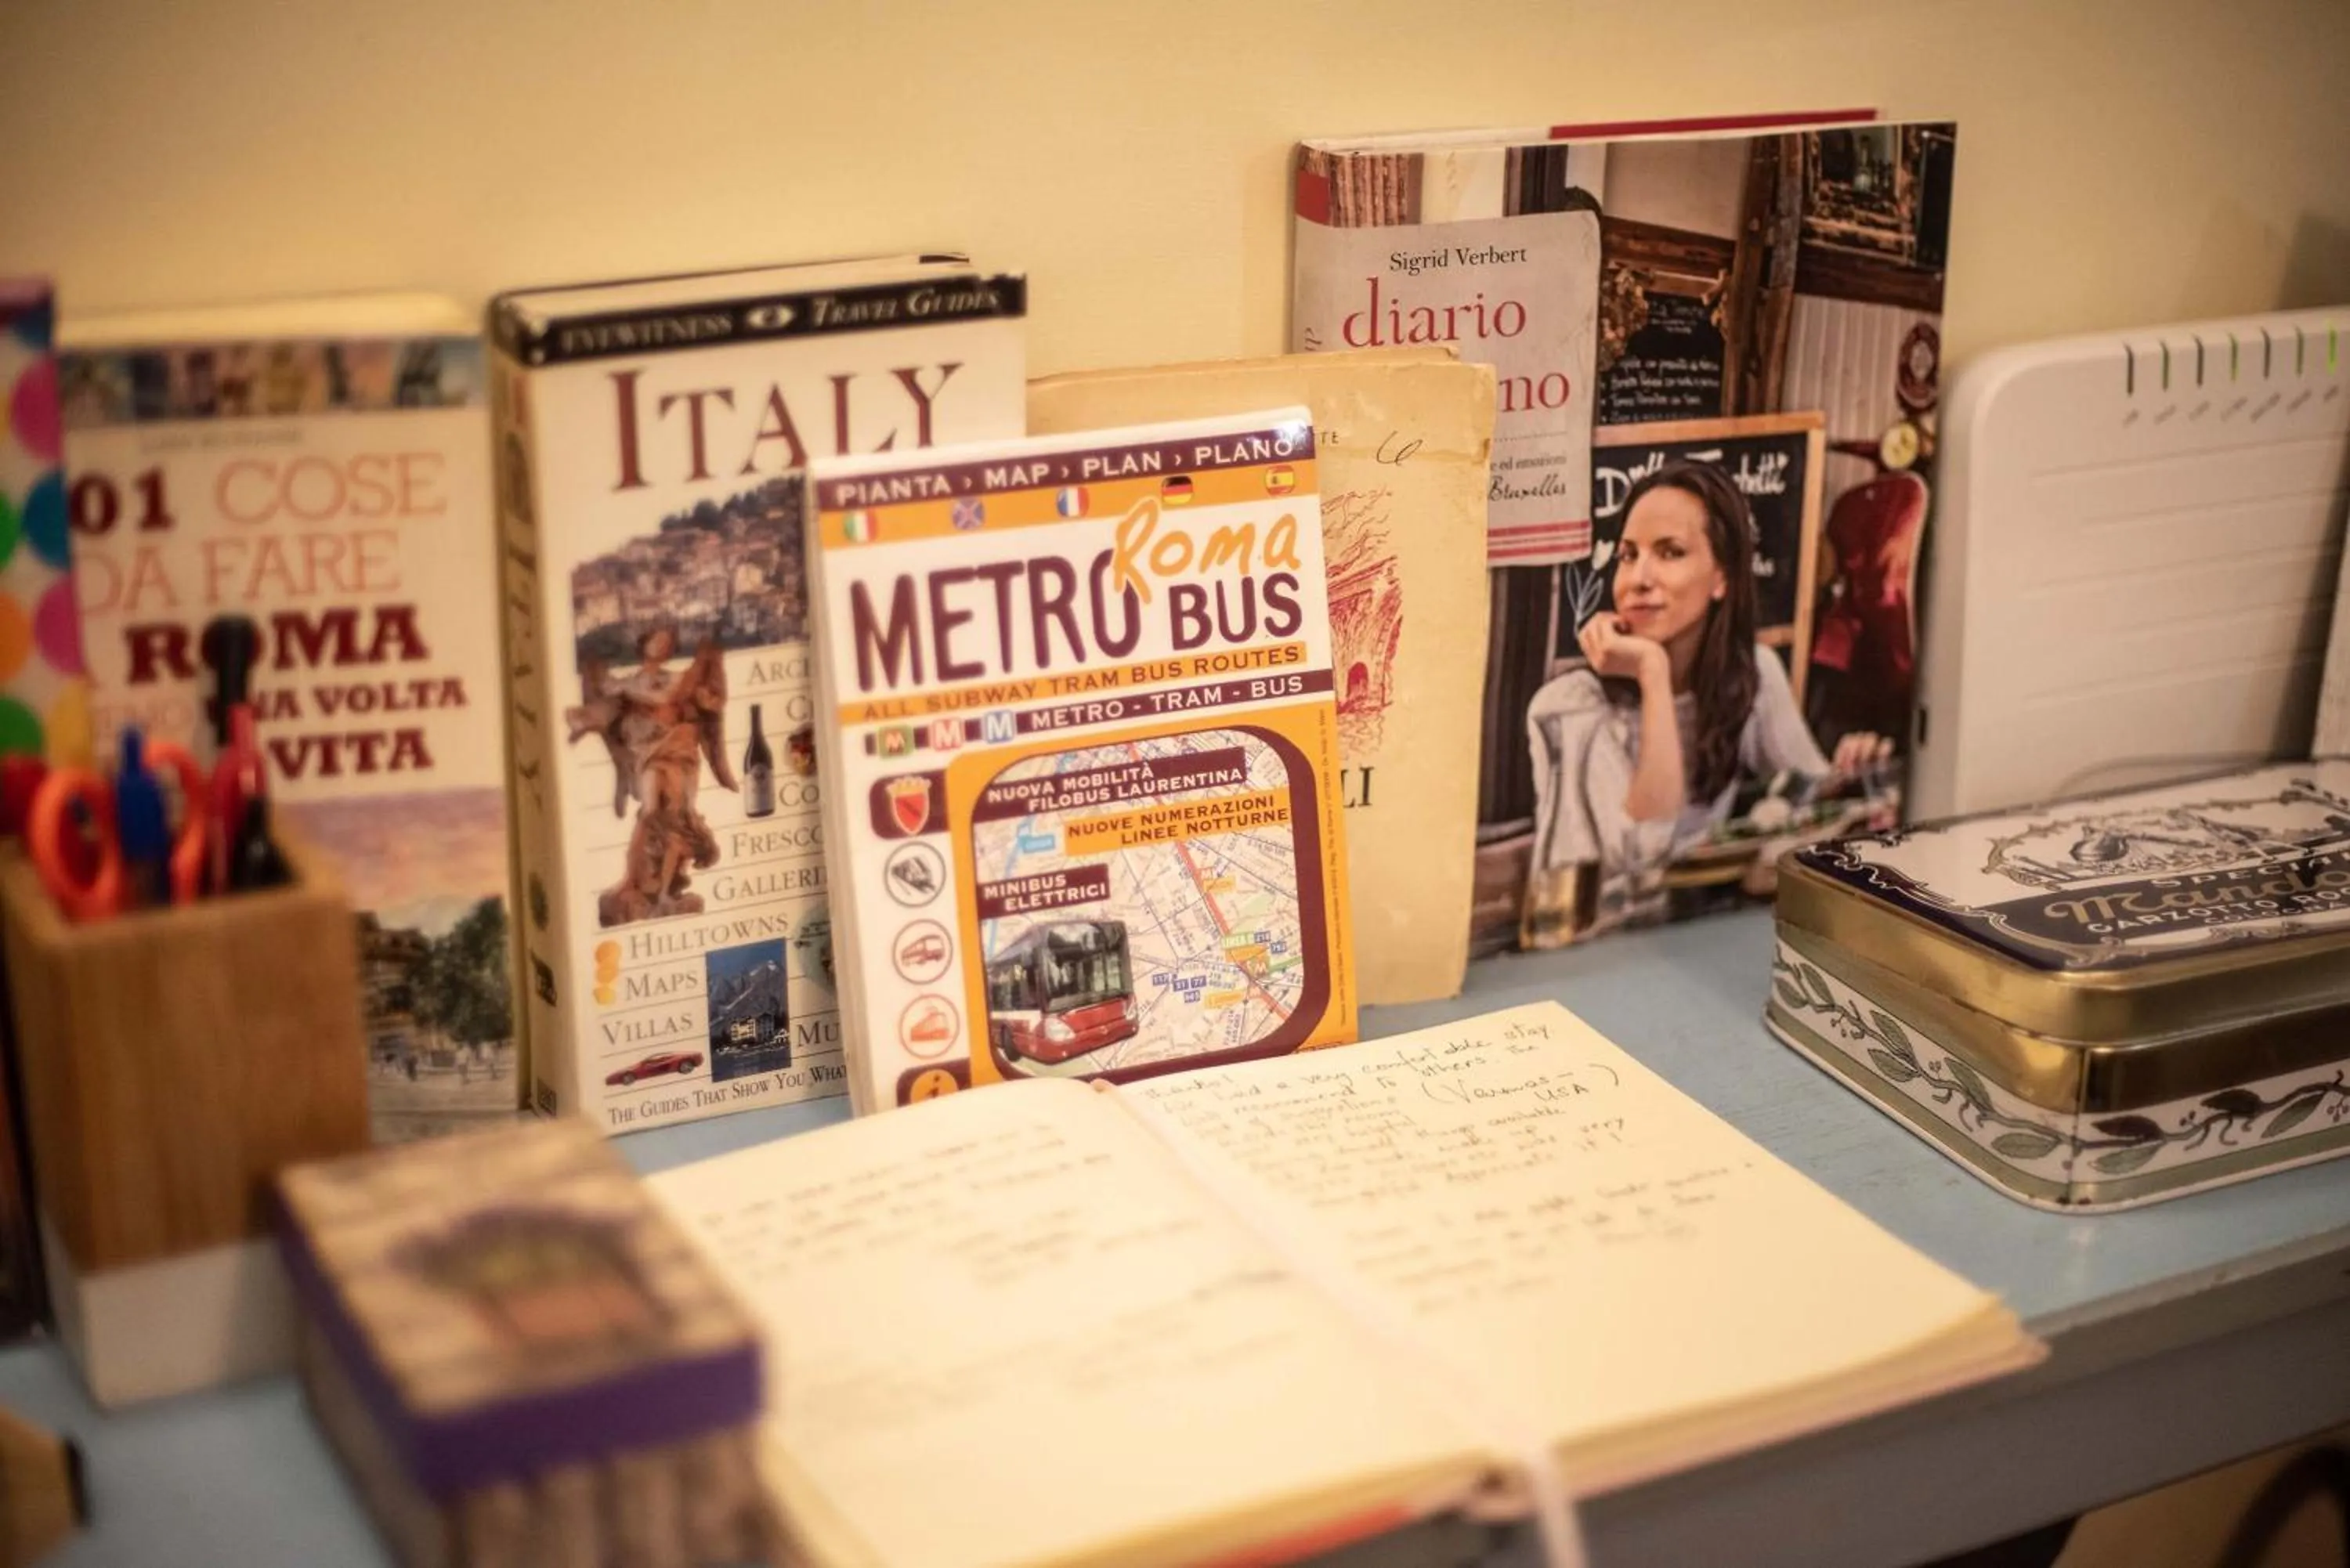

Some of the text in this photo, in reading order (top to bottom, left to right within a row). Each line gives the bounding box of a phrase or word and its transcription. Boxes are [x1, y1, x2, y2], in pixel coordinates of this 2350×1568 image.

[1390, 246, 1528, 275] Sigrid Verbert
[1343, 276, 1526, 347] diario
[213, 451, 448, 525] COSE
[836, 436, 1294, 505] PIANTA MAP PLAN PLANO
[201, 529, 403, 605] FARE
[1112, 497, 1301, 606] Roma
[850, 548, 1303, 694] METRO BUS
[311, 677, 471, 718] VOLTA
[864, 645, 1300, 721] ALL SUBWAY TRAM BUS ROUTES
[1030, 675, 1303, 732] METRO TRAM BUS
[268, 728, 435, 781] VITA
[987, 762, 1155, 804] NUOVA MOBILITÀ
[1028, 768, 1244, 813] FILOBUS LAURENTINA
[1067, 794, 1274, 839] NUOVE NUMERAZIONI
[1121, 807, 1289, 845] LINEE NOTTURNE
[984, 873, 1067, 899] MINIBUS
[1003, 882, 1107, 912] ELETTRICI
[628, 912, 790, 961] HILLTOWNS
[627, 972, 698, 1003] MAPS
[601, 1012, 694, 1047] VILLAS
[1300, 1071, 1354, 1087] very
[1504, 1023, 1550, 1041] stay
[609, 1107, 635, 1125] THE
[640, 1099, 689, 1118] GUIDES
[692, 1088, 728, 1107] THAT
[732, 1078, 771, 1099] SHOW
[776, 1071, 805, 1090] YOU
